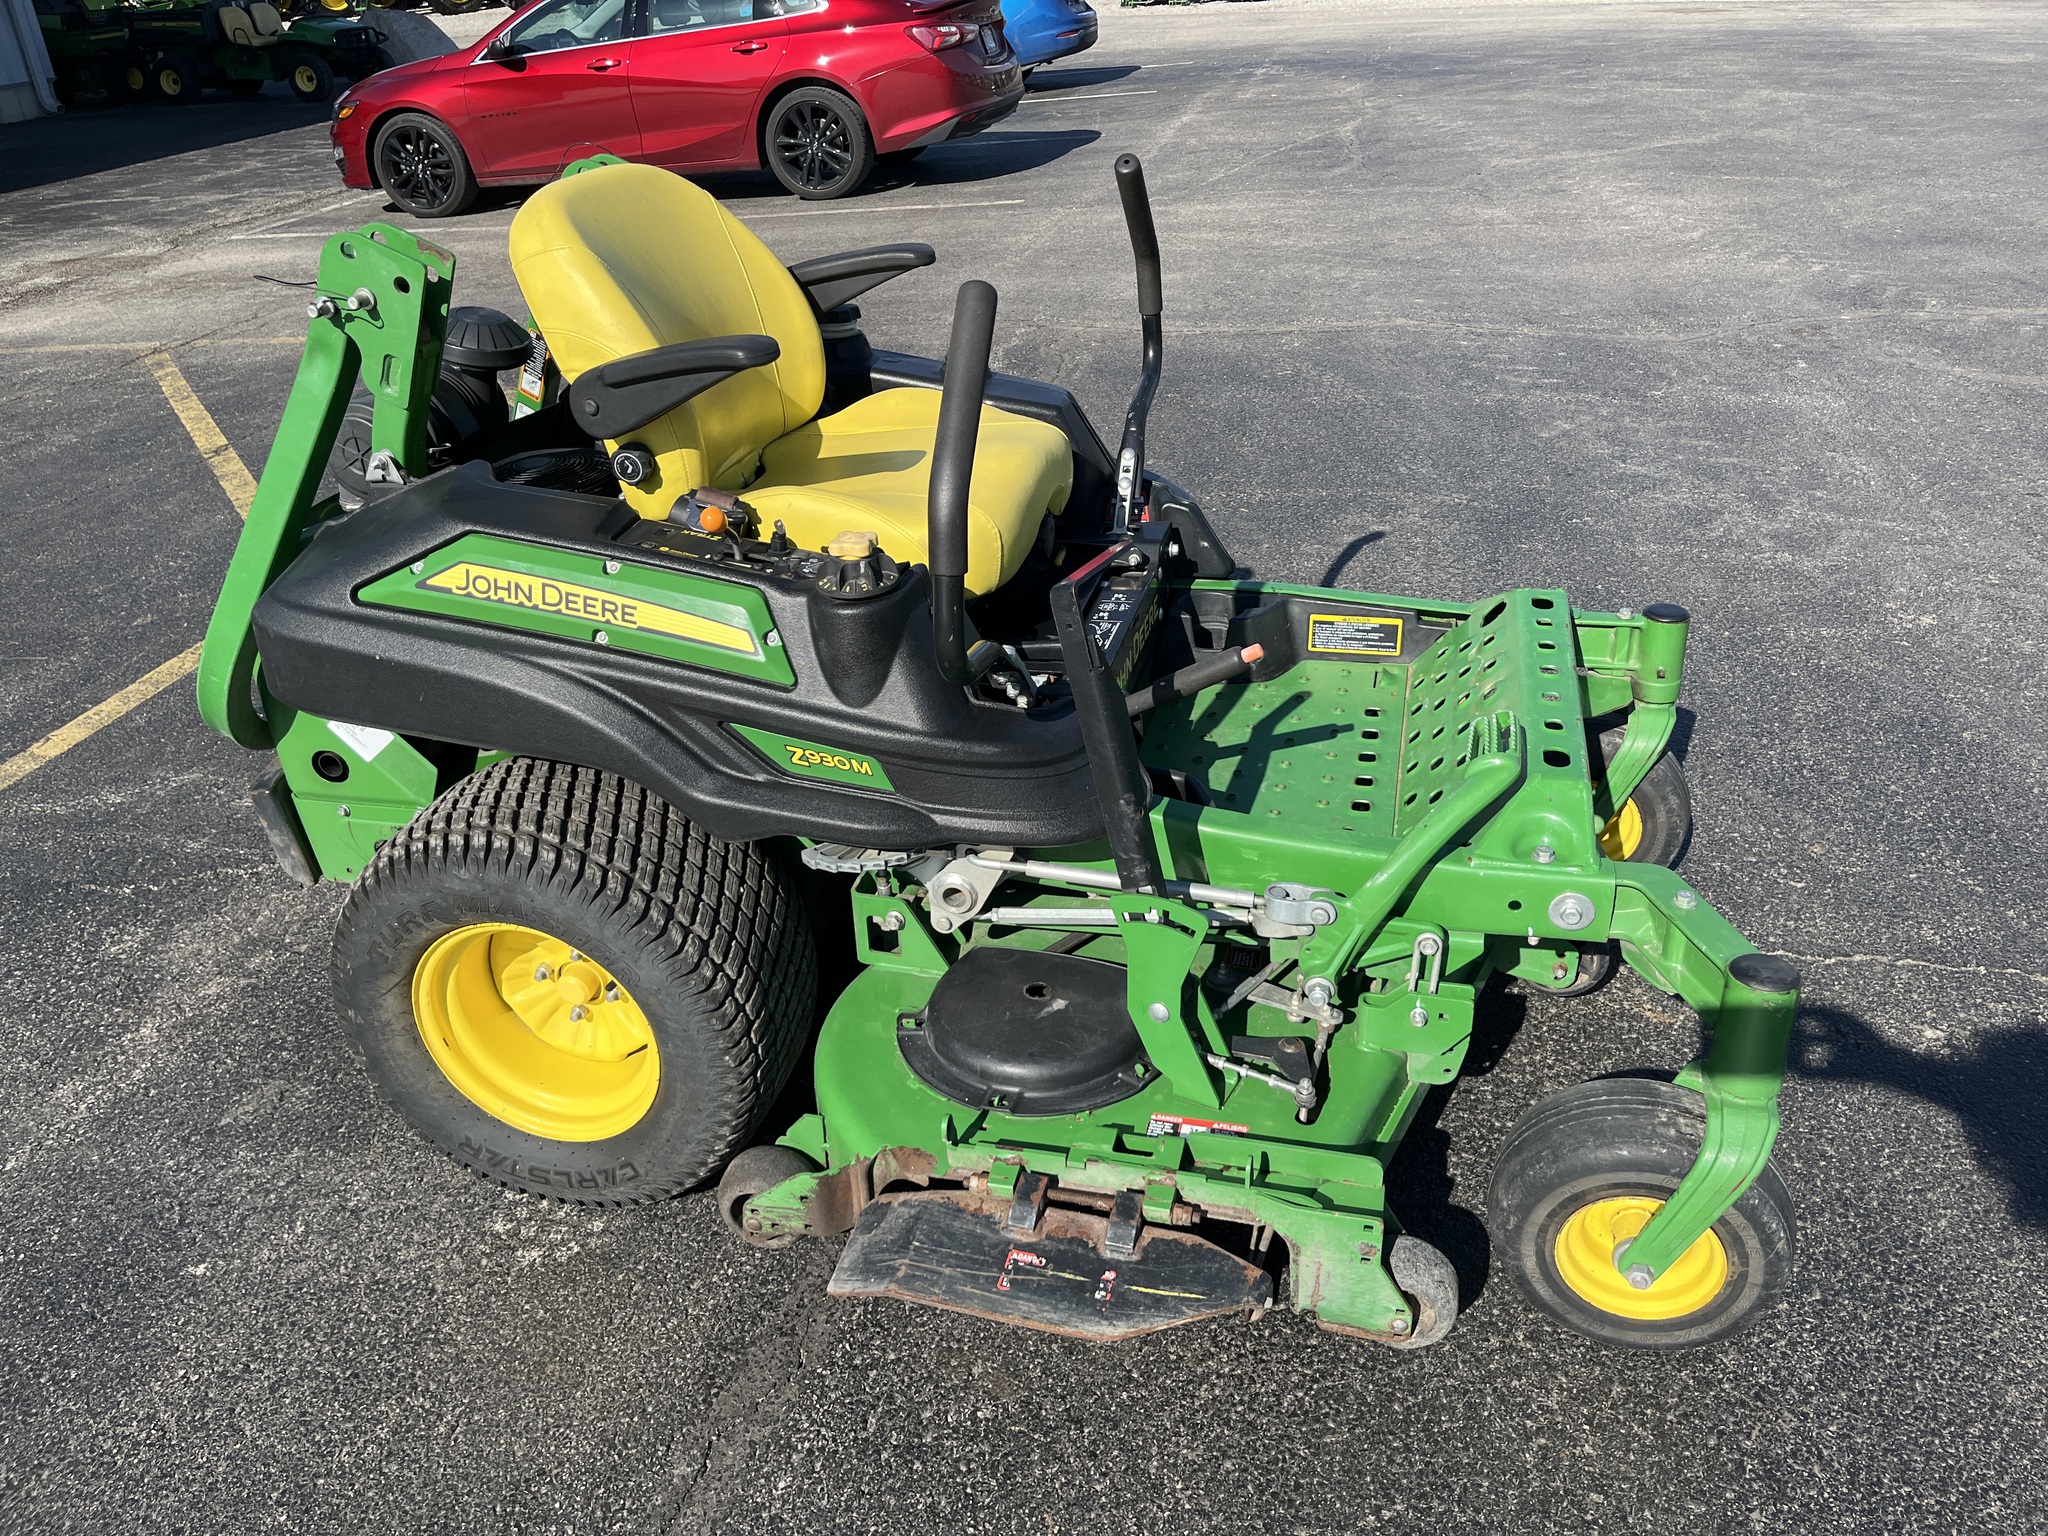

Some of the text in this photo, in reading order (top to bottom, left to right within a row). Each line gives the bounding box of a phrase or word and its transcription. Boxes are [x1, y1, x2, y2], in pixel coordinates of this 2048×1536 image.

[455, 568, 639, 626] JOHN DEERE
[784, 744, 874, 776] Z930M
[366, 894, 642, 987] TURF MASTER
[1156, 1113, 1183, 1123] DANGER
[1219, 1122, 1248, 1132] PELIGRO
